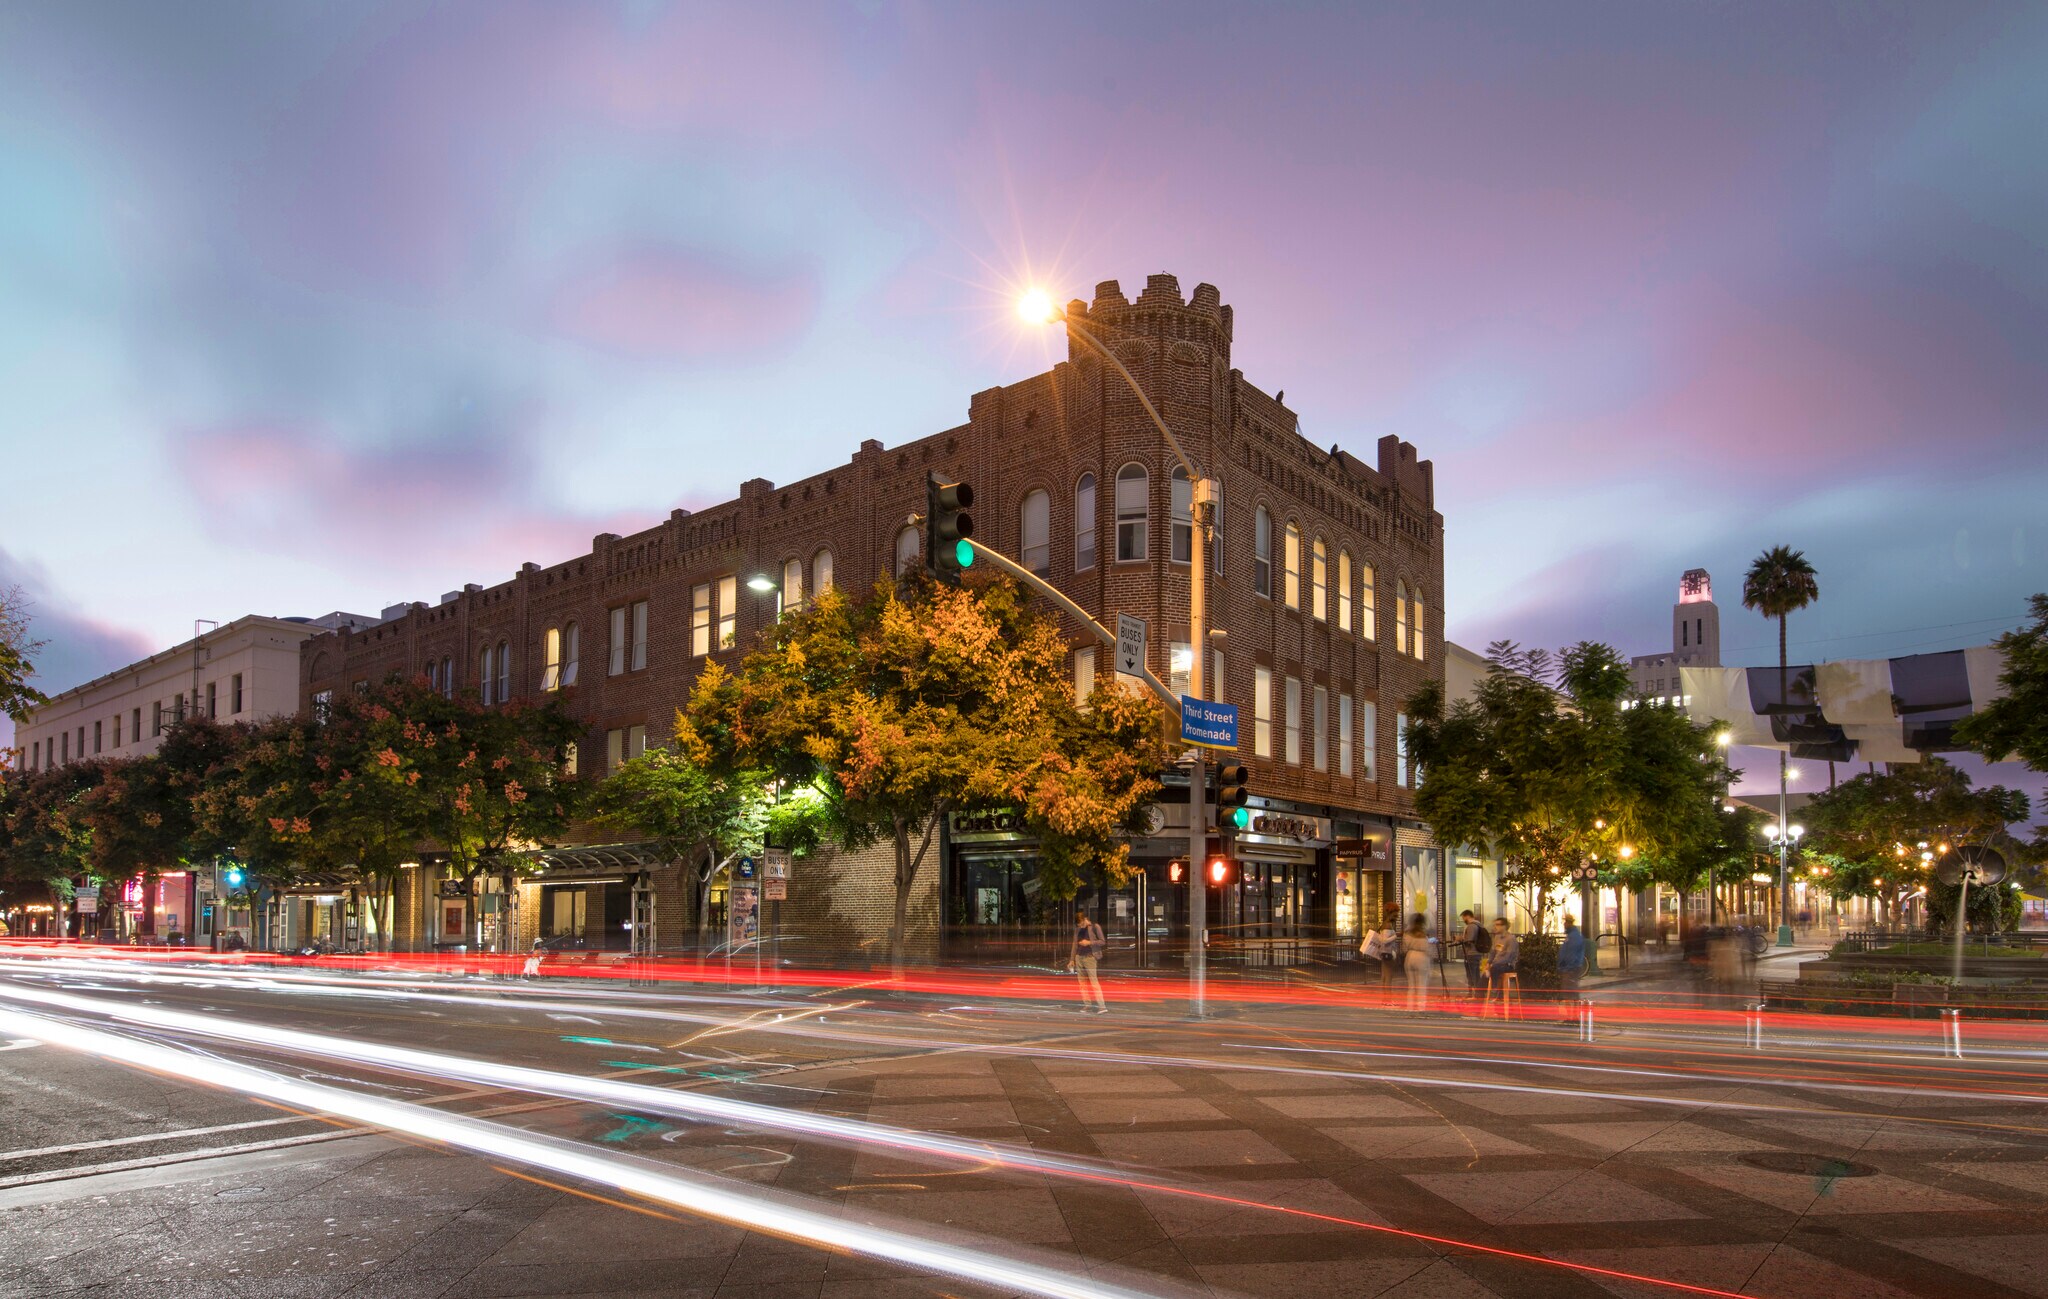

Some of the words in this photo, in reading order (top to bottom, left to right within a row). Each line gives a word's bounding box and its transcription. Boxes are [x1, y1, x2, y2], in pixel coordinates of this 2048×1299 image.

[1120, 626, 1142, 643] BUSES
[1122, 641, 1139, 657] ONLY
[1184, 704, 1202, 719] Third
[1204, 710, 1234, 724] Street
[1185, 722, 1231, 741] Promenade
[768, 856, 788, 865] BUSES
[1371, 851, 1386, 860] PYRUS
[770, 866, 786, 875] ONLY
